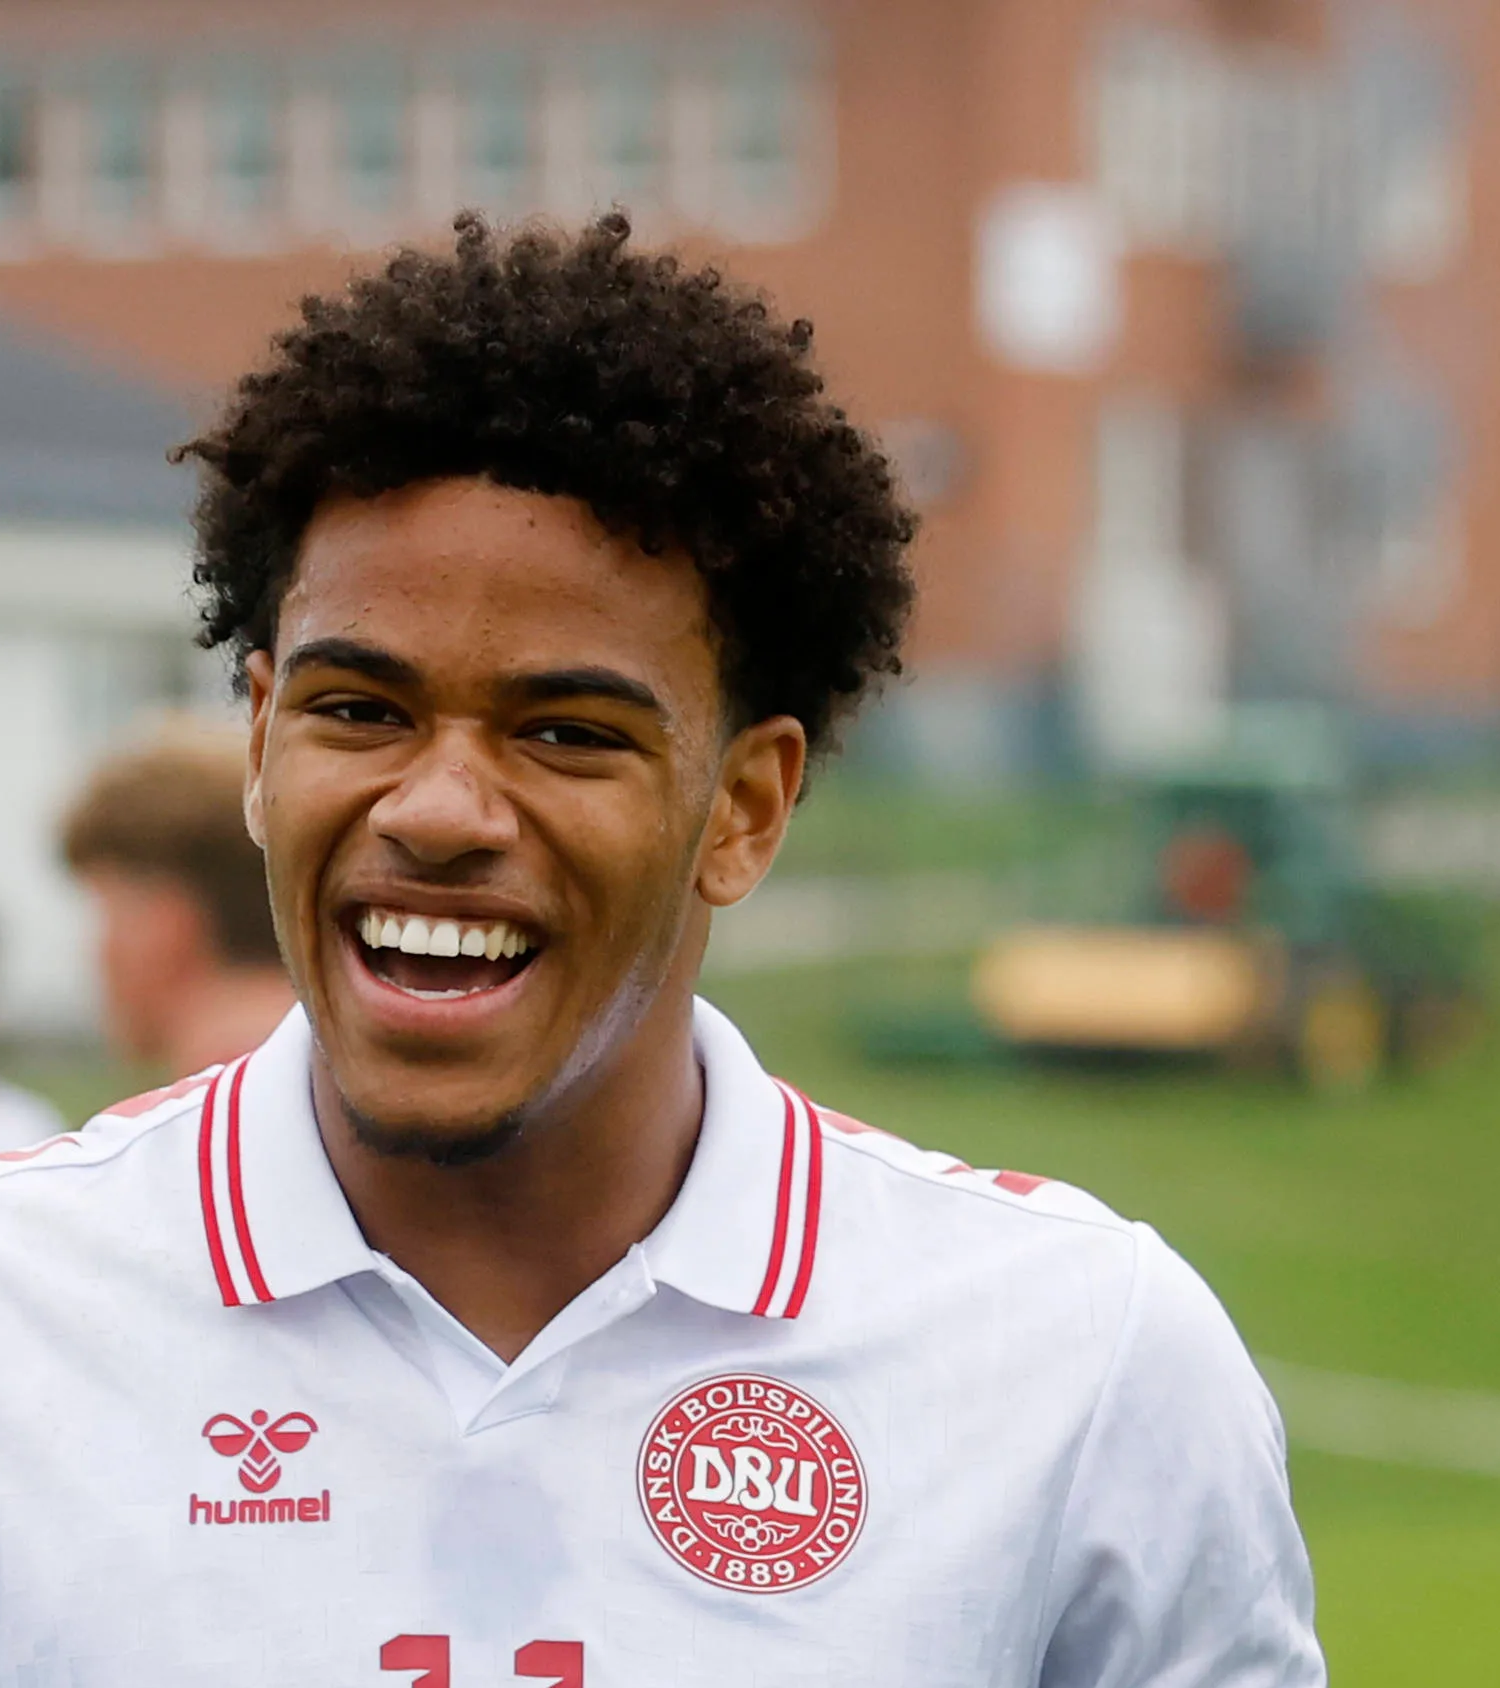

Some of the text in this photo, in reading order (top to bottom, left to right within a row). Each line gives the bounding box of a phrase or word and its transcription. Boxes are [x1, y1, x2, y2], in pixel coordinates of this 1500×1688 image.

[189, 1489, 331, 1525] hummel
[646, 1425, 699, 1554] DANSK
[685, 1444, 818, 1517] DBU
[703, 1552, 796, 1585] 1889
